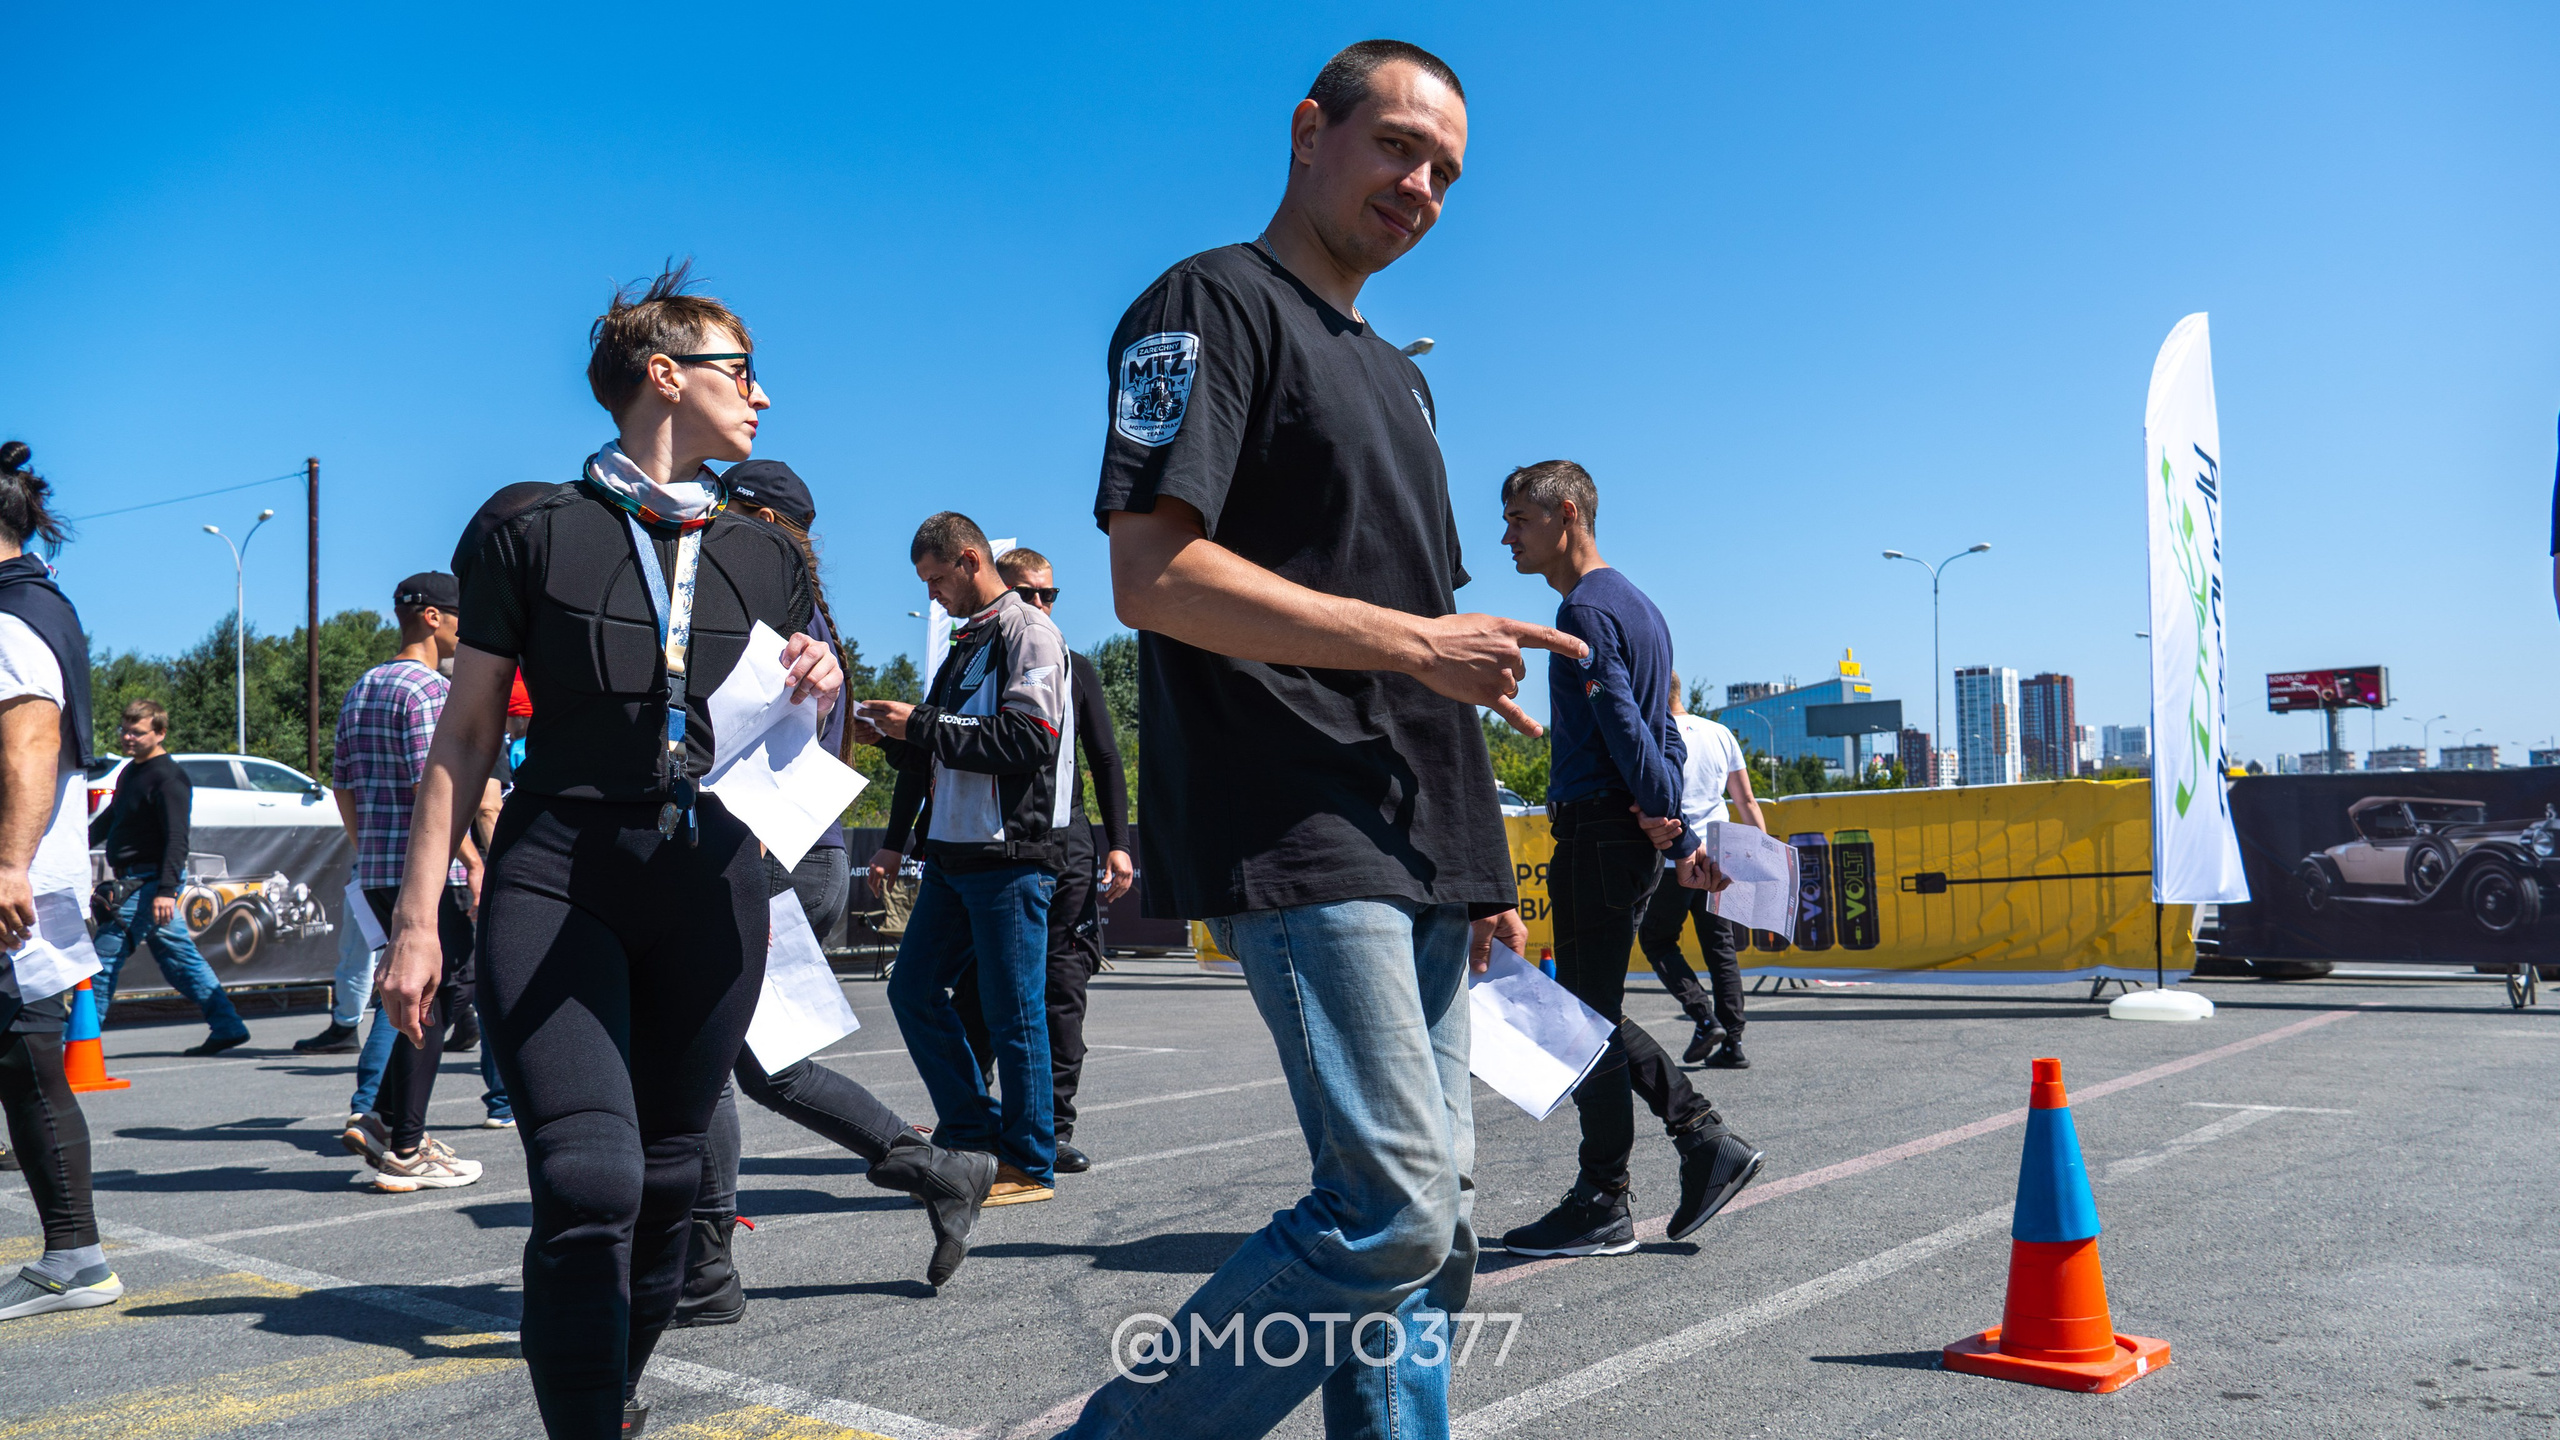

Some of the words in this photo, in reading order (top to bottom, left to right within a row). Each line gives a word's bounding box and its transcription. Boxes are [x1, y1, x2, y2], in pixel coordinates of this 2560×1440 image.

[1139, 343, 1180, 355] ZARECHNY
[1128, 352, 1188, 384] MTZ
[963, 645, 986, 675] HONDA
[1022, 681, 1053, 693] HONDA
[1800, 853, 1822, 921] VOLT
[1842, 851, 1867, 921] VOLT
